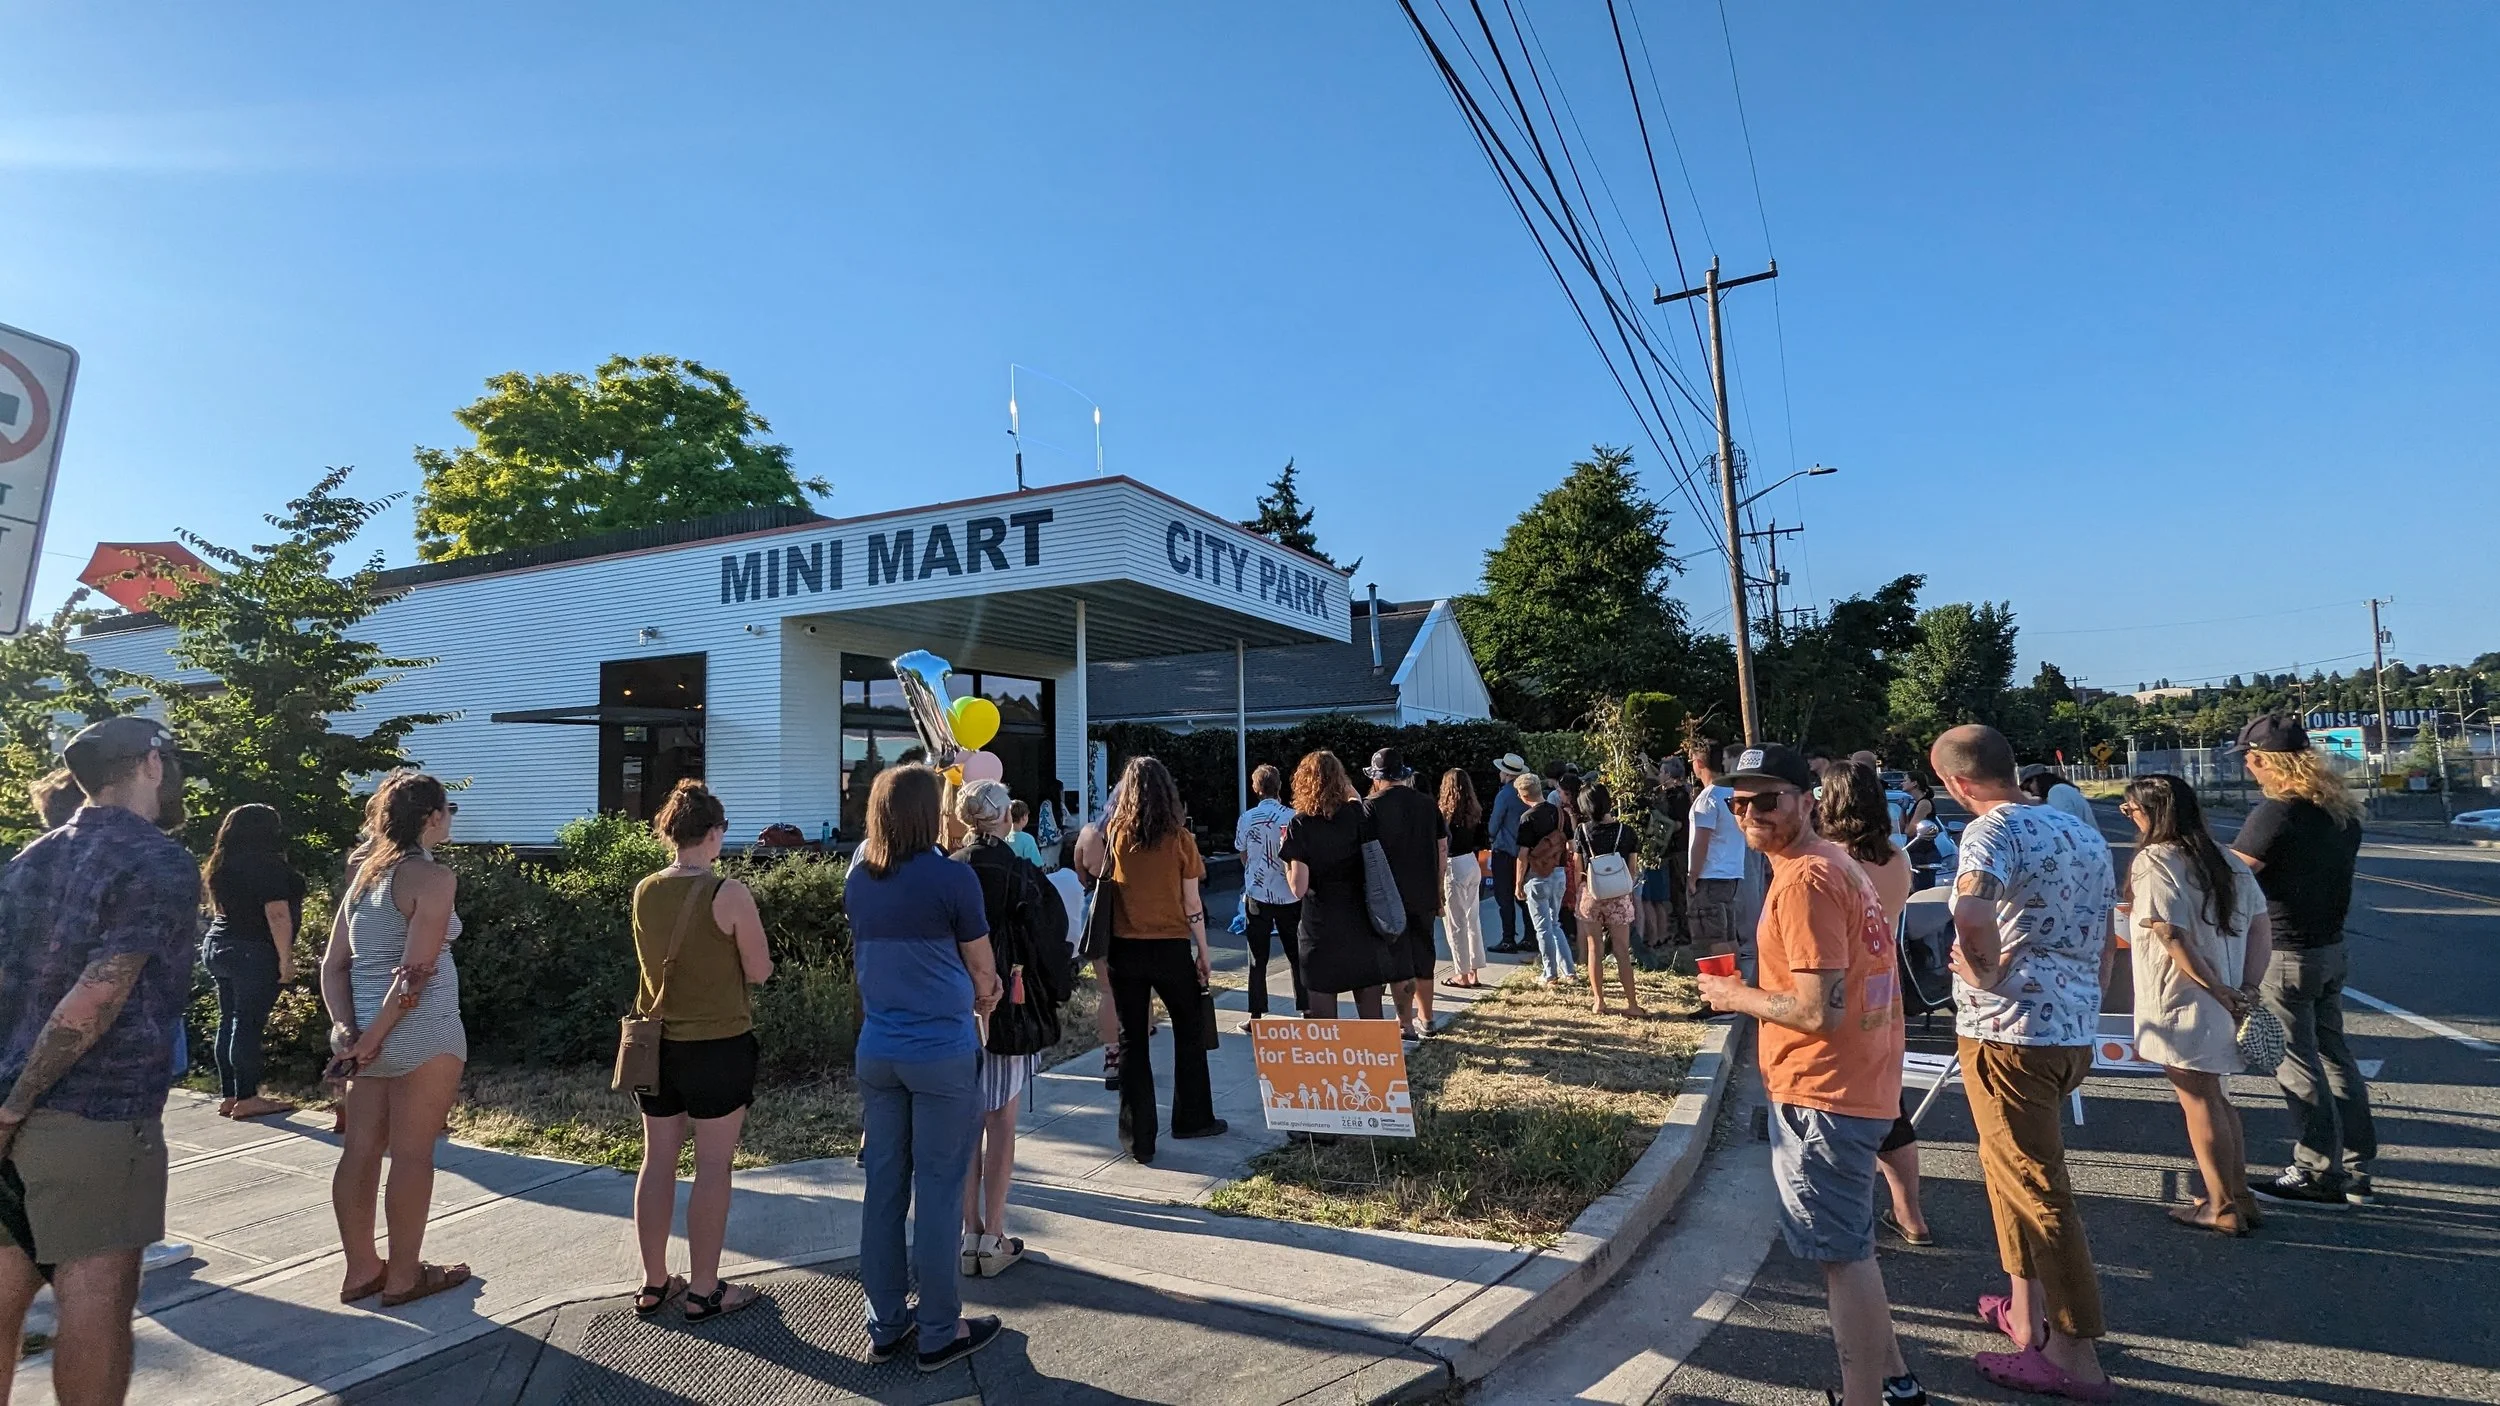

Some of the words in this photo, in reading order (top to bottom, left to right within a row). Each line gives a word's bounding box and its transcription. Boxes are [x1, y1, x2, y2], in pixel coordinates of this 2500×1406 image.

[721, 539, 843, 605] MINI
[868, 508, 1054, 586] MART
[1166, 520, 1250, 593] CITY
[1260, 555, 1330, 621] PARK
[1255, 1022, 1303, 1041] Look
[1306, 1022, 1341, 1041] Out
[1258, 1046, 1286, 1064] for
[1291, 1046, 1338, 1065] Each
[1342, 1048, 1399, 1067] Other
